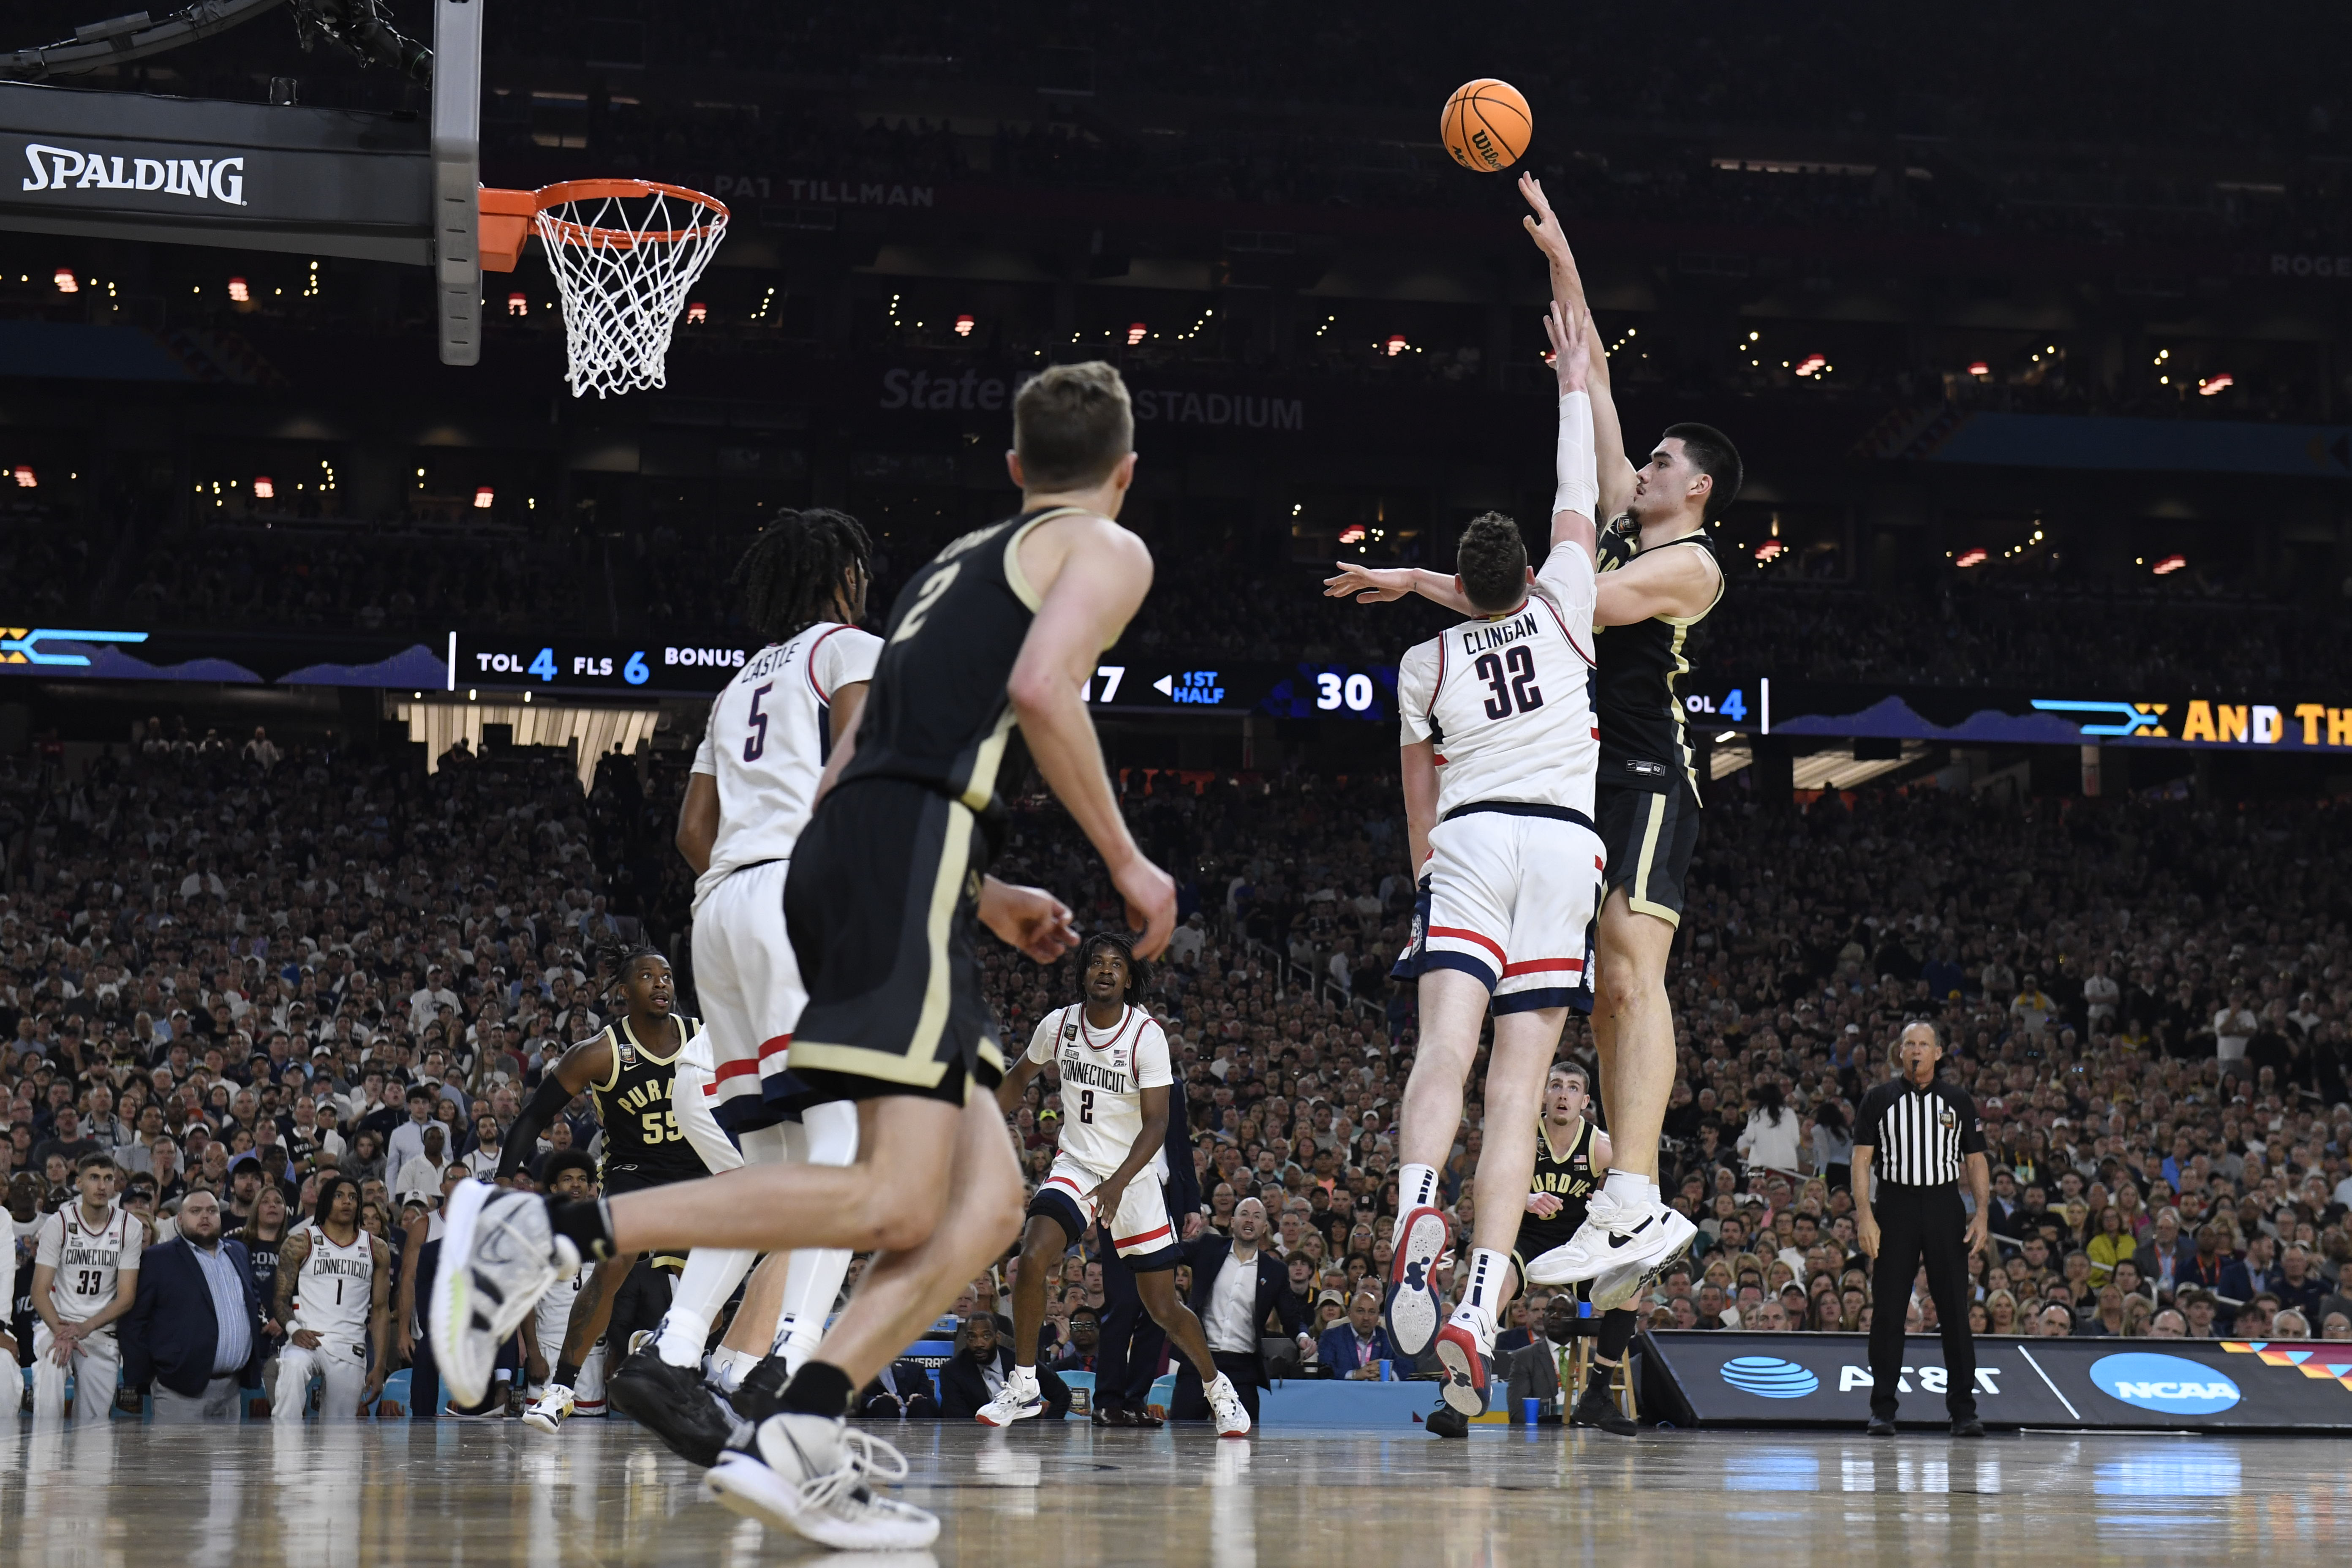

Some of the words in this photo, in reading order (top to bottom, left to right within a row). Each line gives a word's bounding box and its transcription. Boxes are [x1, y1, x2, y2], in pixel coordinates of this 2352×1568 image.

[23, 144, 244, 205] SPALDING
[787, 179, 934, 207] TILLMAN
[879, 368, 1005, 411] State
[1135, 389, 1304, 430] STADIUM
[889, 560, 961, 645] 2
[1463, 612, 1538, 655] CLINGAN
[477, 653, 523, 672] TOL
[528, 648, 558, 681] 4
[574, 656, 613, 676] FLS
[623, 651, 650, 685] 6
[665, 647, 745, 667] BONUS
[741, 642, 800, 684] CASTLE
[1183, 672, 1218, 687] 1ST
[1173, 687, 1225, 704] HALF
[1317, 672, 1373, 711] 30
[1475, 645, 1544, 720] 32
[743, 681, 774, 762] 5
[1685, 694, 1716, 713] OL
[1719, 688, 1748, 721] 4
[2181, 699, 2284, 743] AND
[2294, 703, 2352, 746] TH
[1061, 1059, 1126, 1094] CONNECTICUT
[1081, 1090, 1094, 1124] 2
[642, 1109, 683, 1144] 55
[1532, 1172, 1591, 1198] URDUE
[65, 1248, 119, 1267] CONNECTICUT
[313, 1259, 369, 1279] CONNECTICUT
[77, 1270, 102, 1295] 33
[336, 1279, 343, 1305] 1
[2115, 1381, 2241, 1399] NCAA
